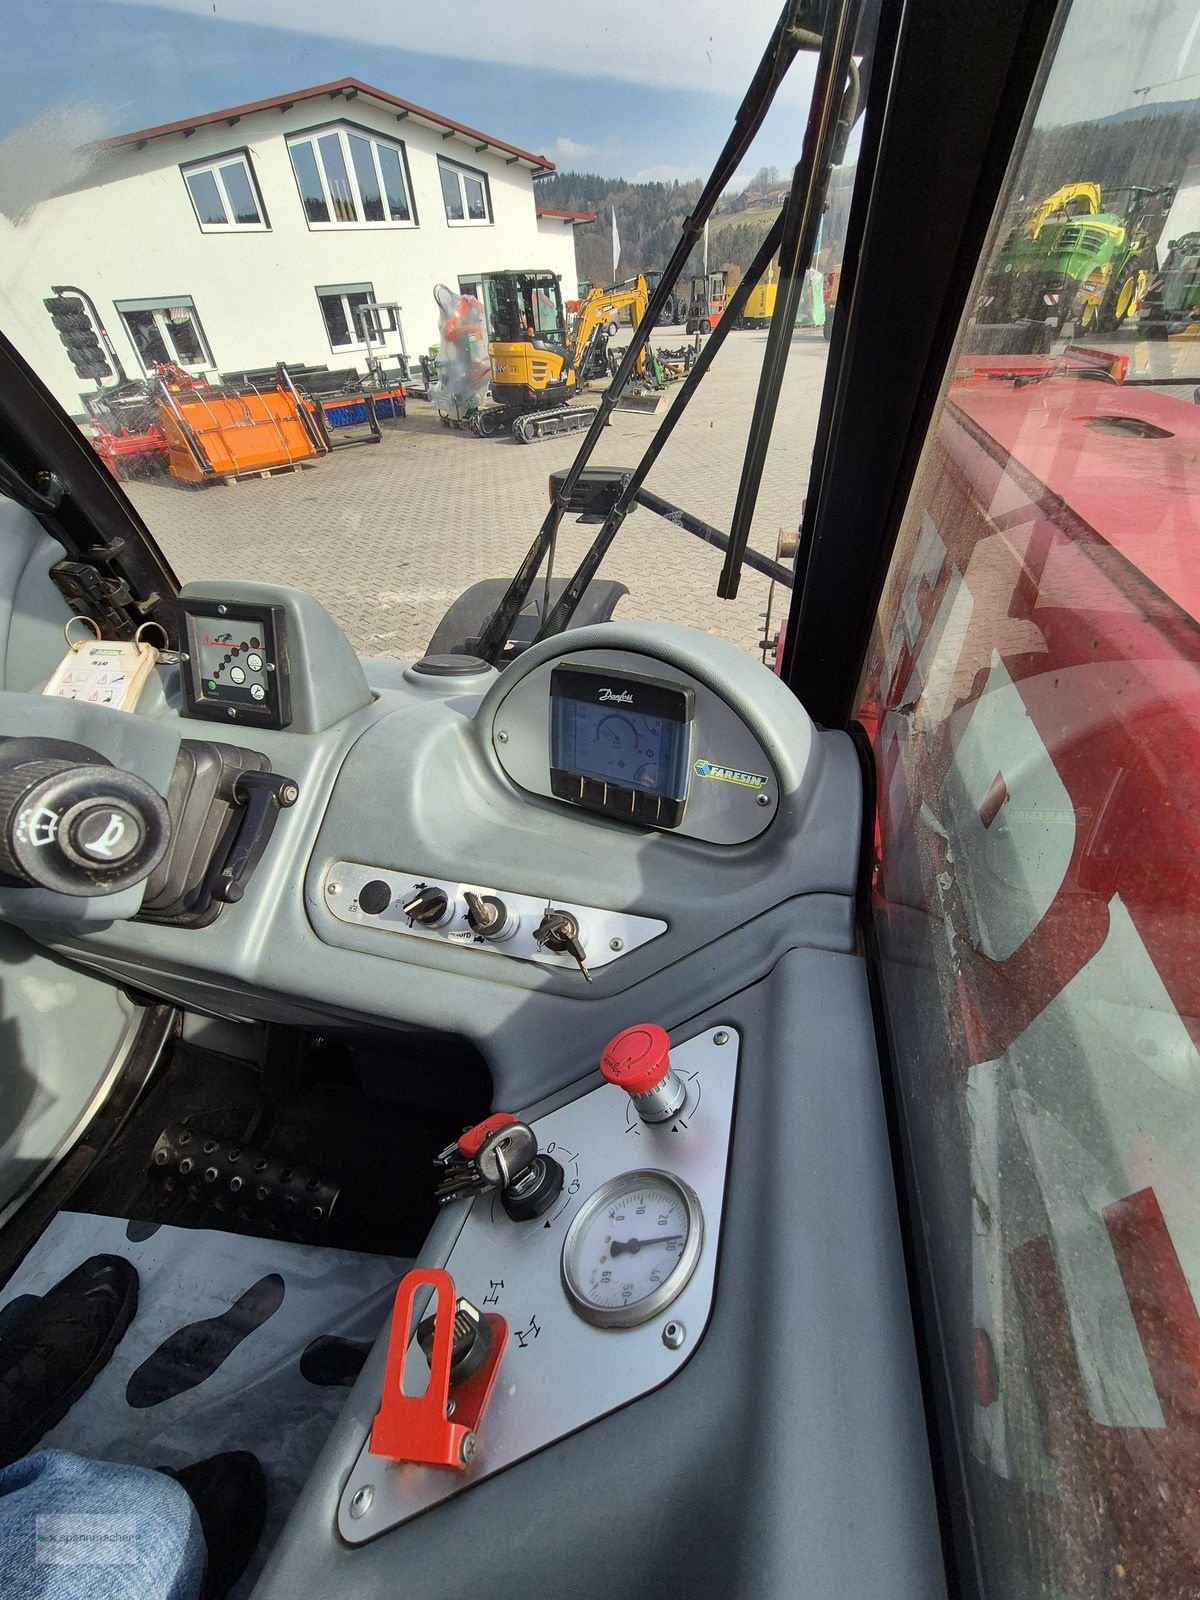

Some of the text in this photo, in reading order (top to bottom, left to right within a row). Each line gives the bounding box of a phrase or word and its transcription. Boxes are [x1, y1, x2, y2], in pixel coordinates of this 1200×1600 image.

[598, 688, 634, 704] Danfoss
[709, 767, 762, 786] FARESIN
[636, 1205, 647, 1215] 10
[658, 1214, 669, 1226] 20
[621, 1284, 634, 1298] 50
